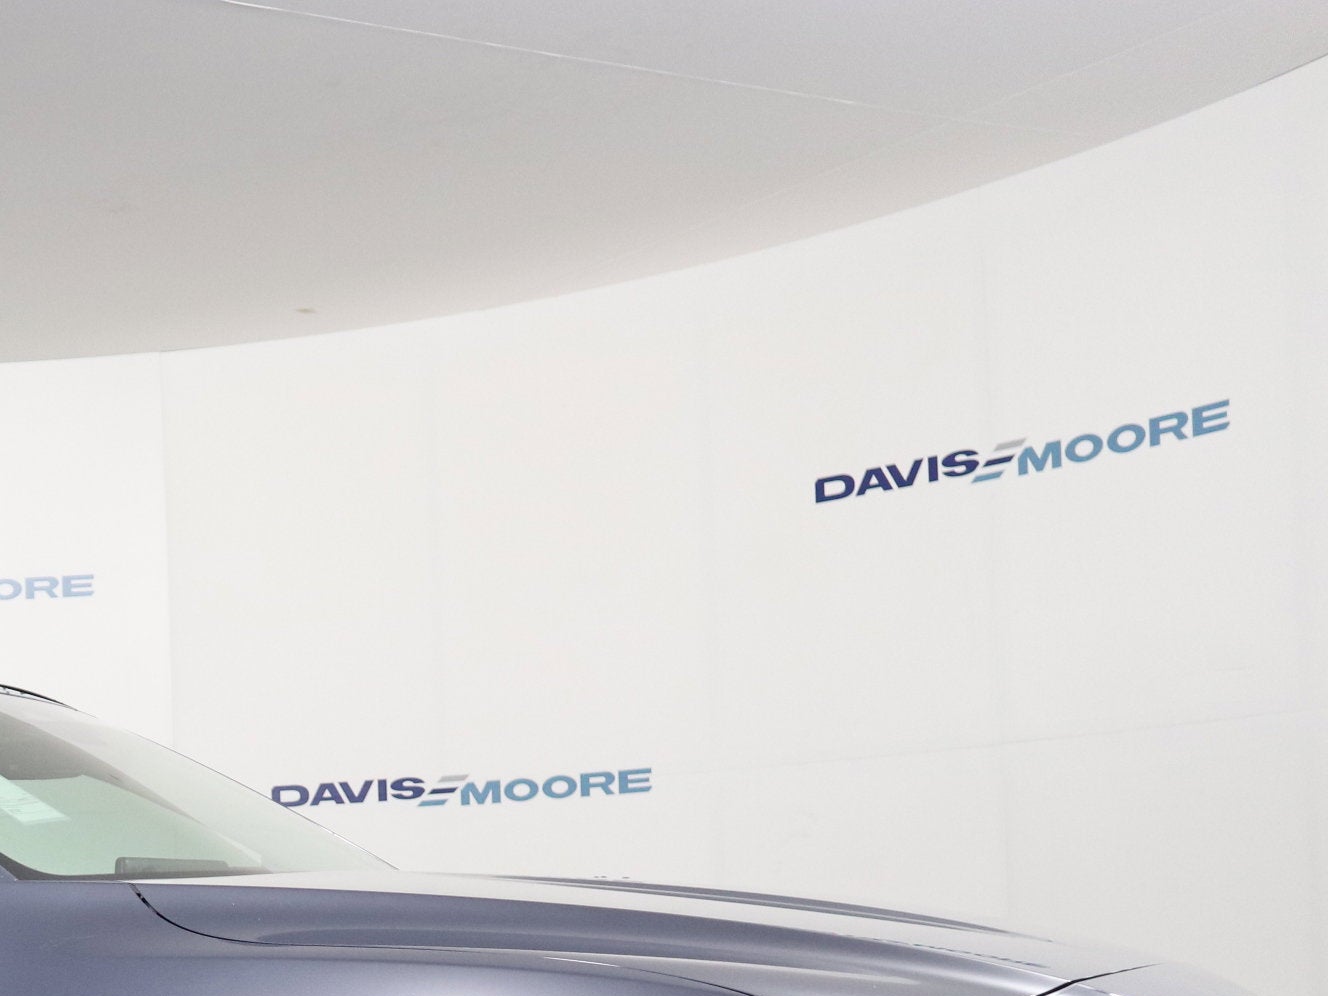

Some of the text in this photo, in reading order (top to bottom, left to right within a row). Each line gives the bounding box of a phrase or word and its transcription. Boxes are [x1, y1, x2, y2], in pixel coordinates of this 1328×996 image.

[815, 399, 1229, 503] DAVIS MOORE
[272, 768, 652, 807] DAVIS MOORE
